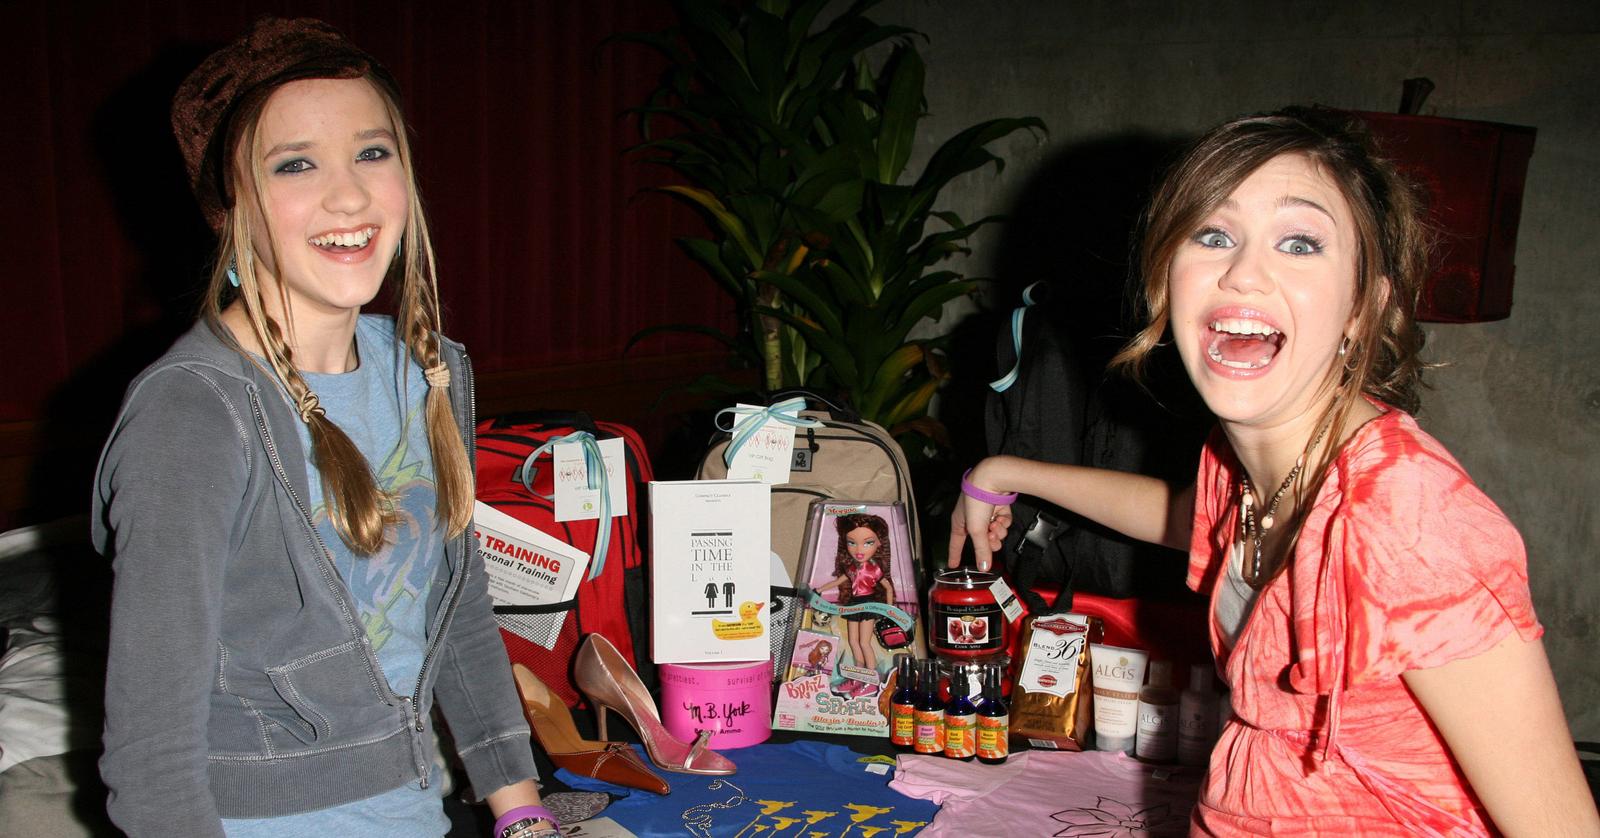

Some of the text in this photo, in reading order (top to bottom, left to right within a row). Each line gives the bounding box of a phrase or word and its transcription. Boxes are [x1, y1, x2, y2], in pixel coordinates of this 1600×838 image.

[485, 535, 561, 574] TRAINING
[691, 538, 733, 548] PASSING
[691, 548, 733, 561] TIME
[477, 548, 514, 568] ersonal
[517, 562, 557, 586] Training
[691, 562, 733, 571] IN THE
[1033, 637, 1084, 661] BLEND 36
[727, 676, 755, 687] survival
[784, 675, 826, 700] BRATZ
[723, 700, 756, 728] York
